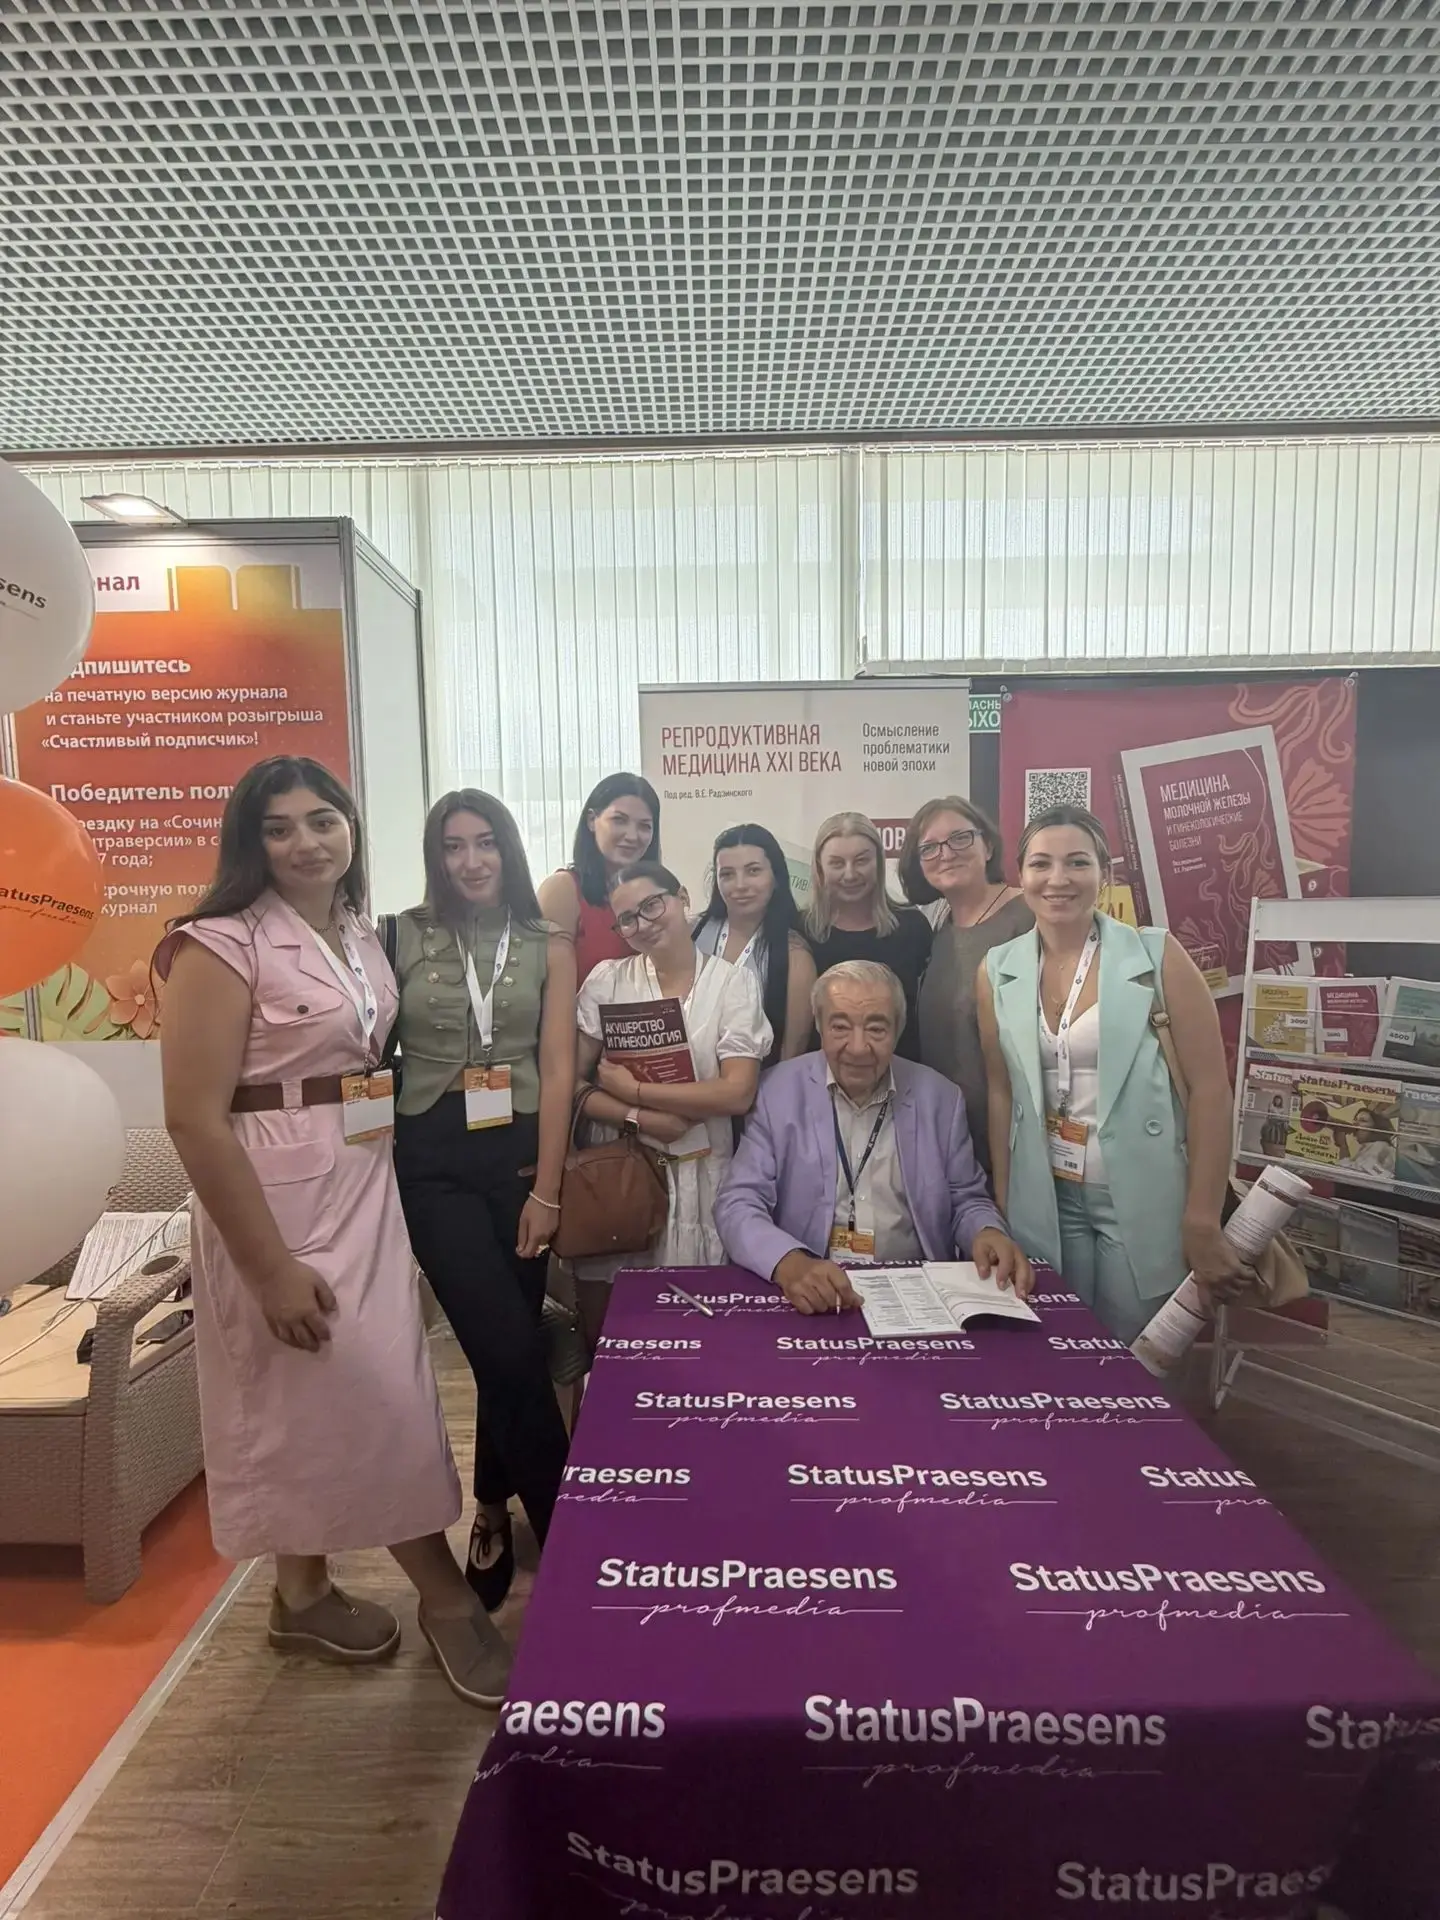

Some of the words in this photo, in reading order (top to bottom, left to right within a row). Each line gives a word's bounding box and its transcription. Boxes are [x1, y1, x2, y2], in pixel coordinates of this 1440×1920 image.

[97, 575, 140, 592] нал
[45, 689, 63, 702] на
[67, 688, 146, 705] печатную
[151, 688, 214, 702] версию
[216, 686, 288, 703] журнала
[46, 713, 56, 725] и
[60, 711, 121, 726] станьте
[126, 710, 224, 727] участником
[227, 709, 324, 726] розыгрыша
[661, 723, 821, 750] РЕПРОДУКТИВНАЯ
[862, 722, 940, 738] Осмысление
[41, 731, 150, 749] «Счастливый
[154, 731, 259, 749] подписчик»!
[863, 740, 951, 757] проблематики
[662, 752, 761, 778] МЕДИЦИНА
[766, 751, 793, 773] XXI
[799, 751, 843, 773] ВЕКА
[863, 758, 899, 772] новой
[901, 759, 937, 772] эпохи
[50, 783, 185, 804] Победитель
[190, 785, 234, 801] пол
[664, 789, 678, 800] Под
[1159, 773, 1231, 803] МЕДИЦИНА
[1163, 799, 1212, 821] МОЛОЧНОЙ
[1213, 791, 1252, 811] ЖЕЛЕЗЫ
[140, 816, 159, 830] на
[163, 814, 223, 830] «Сочин
[1166, 824, 1173, 836] И
[197, 836, 206, 847] в
[210, 835, 222, 847] с
[879, 827, 906, 851] ОВ
[112, 854, 153, 868] года;
[177, 884, 214, 898] под
[605, 1018, 665, 1035] АКУШЕРСТВО
[606, 1036, 613, 1048] И
[613, 1029, 682, 1048] ГИНЕКОЛОГИЯ
[776, 1336, 976, 1351] StatusPraesens
[811, 1351, 945, 1366] profmedia
[634, 1391, 857, 1410] StatusPraesens
[939, 1391, 1172, 1410] StatusPraesens
[667, 1411, 820, 1430] profmedia
[990, 1411, 1144, 1431] profmedia
[562, 1464, 691, 1485] raesens
[787, 1463, 1048, 1487] StatusPraesens
[834, 1490, 1010, 1514] profmedia
[596, 1557, 898, 1590] StatusPraesens
[1008, 1562, 1326, 1594] StatusPraesens
[639, 1594, 848, 1627] profmedia
[1084, 1600, 1296, 1632] profmedia
[803, 1694, 1167, 1747] StatusPraesens
[862, 1754, 1099, 1790] profmedia
[566, 1830, 919, 1897] StatusPraesens
